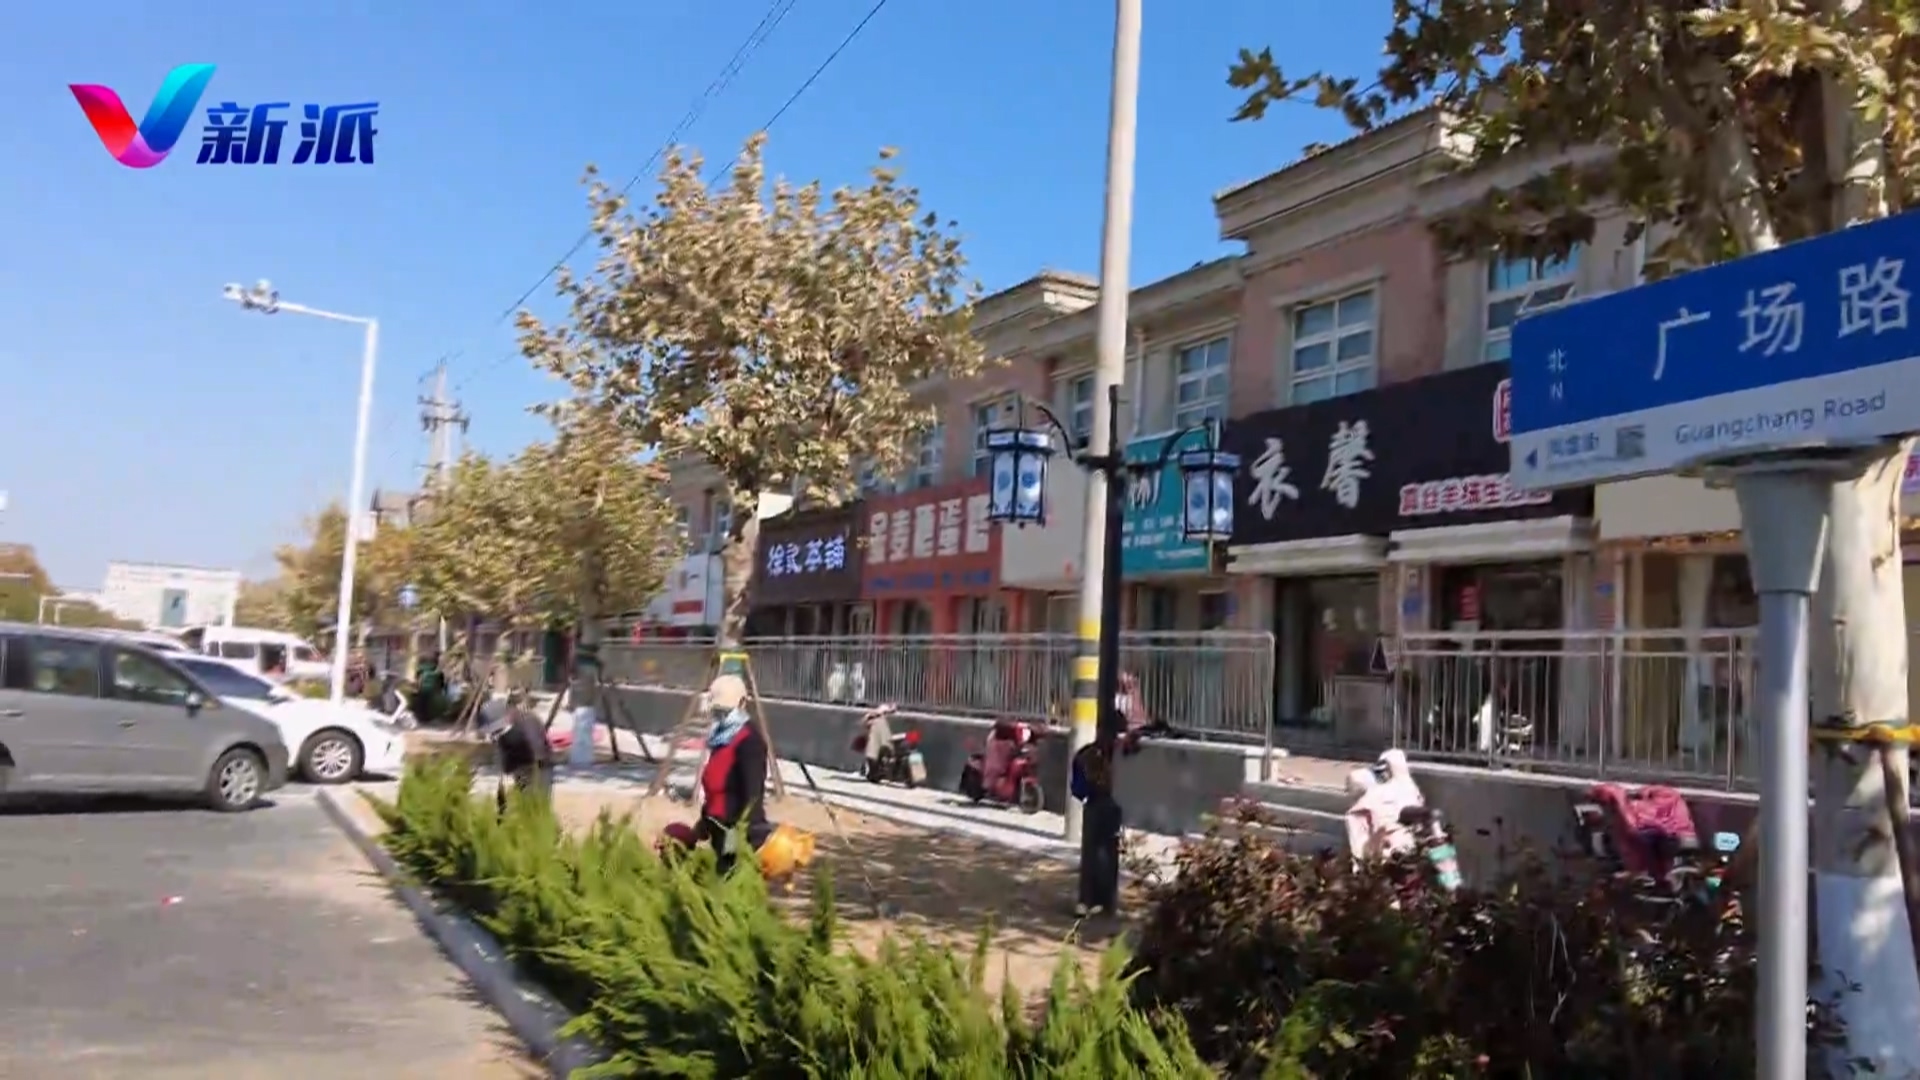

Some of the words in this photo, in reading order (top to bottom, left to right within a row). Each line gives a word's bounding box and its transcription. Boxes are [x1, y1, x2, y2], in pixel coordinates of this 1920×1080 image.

[1653, 256, 1911, 381] 广场路
[1547, 347, 1568, 374] 北
[1550, 381, 1564, 400] N
[1675, 406, 1815, 444] Guangchang
[1824, 390, 1886, 418] Road
[1248, 419, 1376, 521] 衣馨
